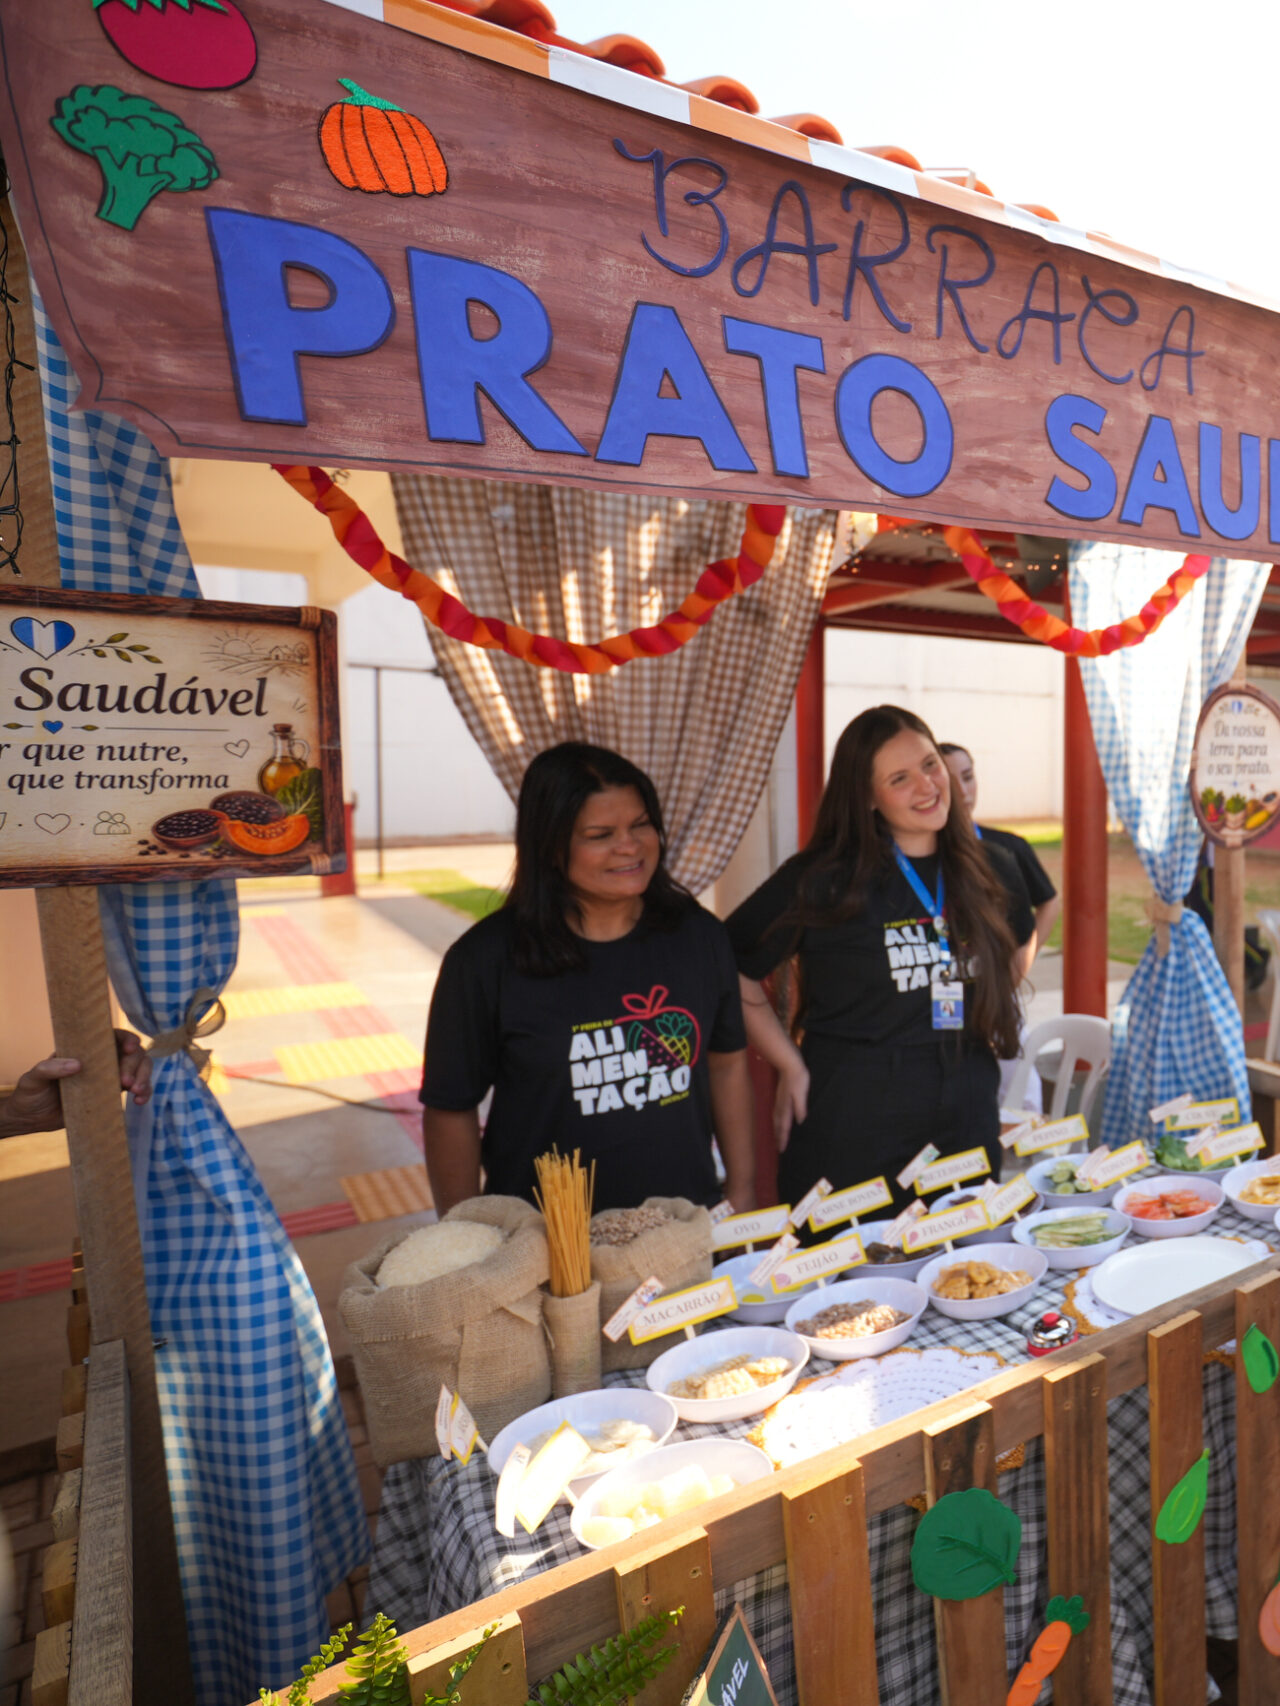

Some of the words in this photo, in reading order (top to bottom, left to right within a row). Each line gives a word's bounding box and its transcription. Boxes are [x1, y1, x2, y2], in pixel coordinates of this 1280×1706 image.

[612, 138, 1205, 396] BARRACA
[204, 206, 954, 499] PRATO
[14, 667, 269, 718] Saudável
[1232, 723, 1266, 737] nossa
[22, 743, 85, 767] que
[96, 741, 189, 765] nutre,
[1209, 743, 1235, 757] terra
[1236, 744, 1268, 760] para
[7, 773, 65, 795] que
[74, 768, 230, 795] transforma
[1215, 762, 1233, 775] seu
[884, 924, 927, 947] ALI
[569, 1025, 626, 1062] ALI
[570, 1048, 649, 1088] MEN
[573, 1064, 691, 1116] TAÇÃO
[733, 1221, 761, 1236] OVO
[921, 1214, 969, 1238] FRANGO
[796, 1251, 840, 1275] FEIJÃO
[642, 1289, 721, 1325] MACARRÃO
